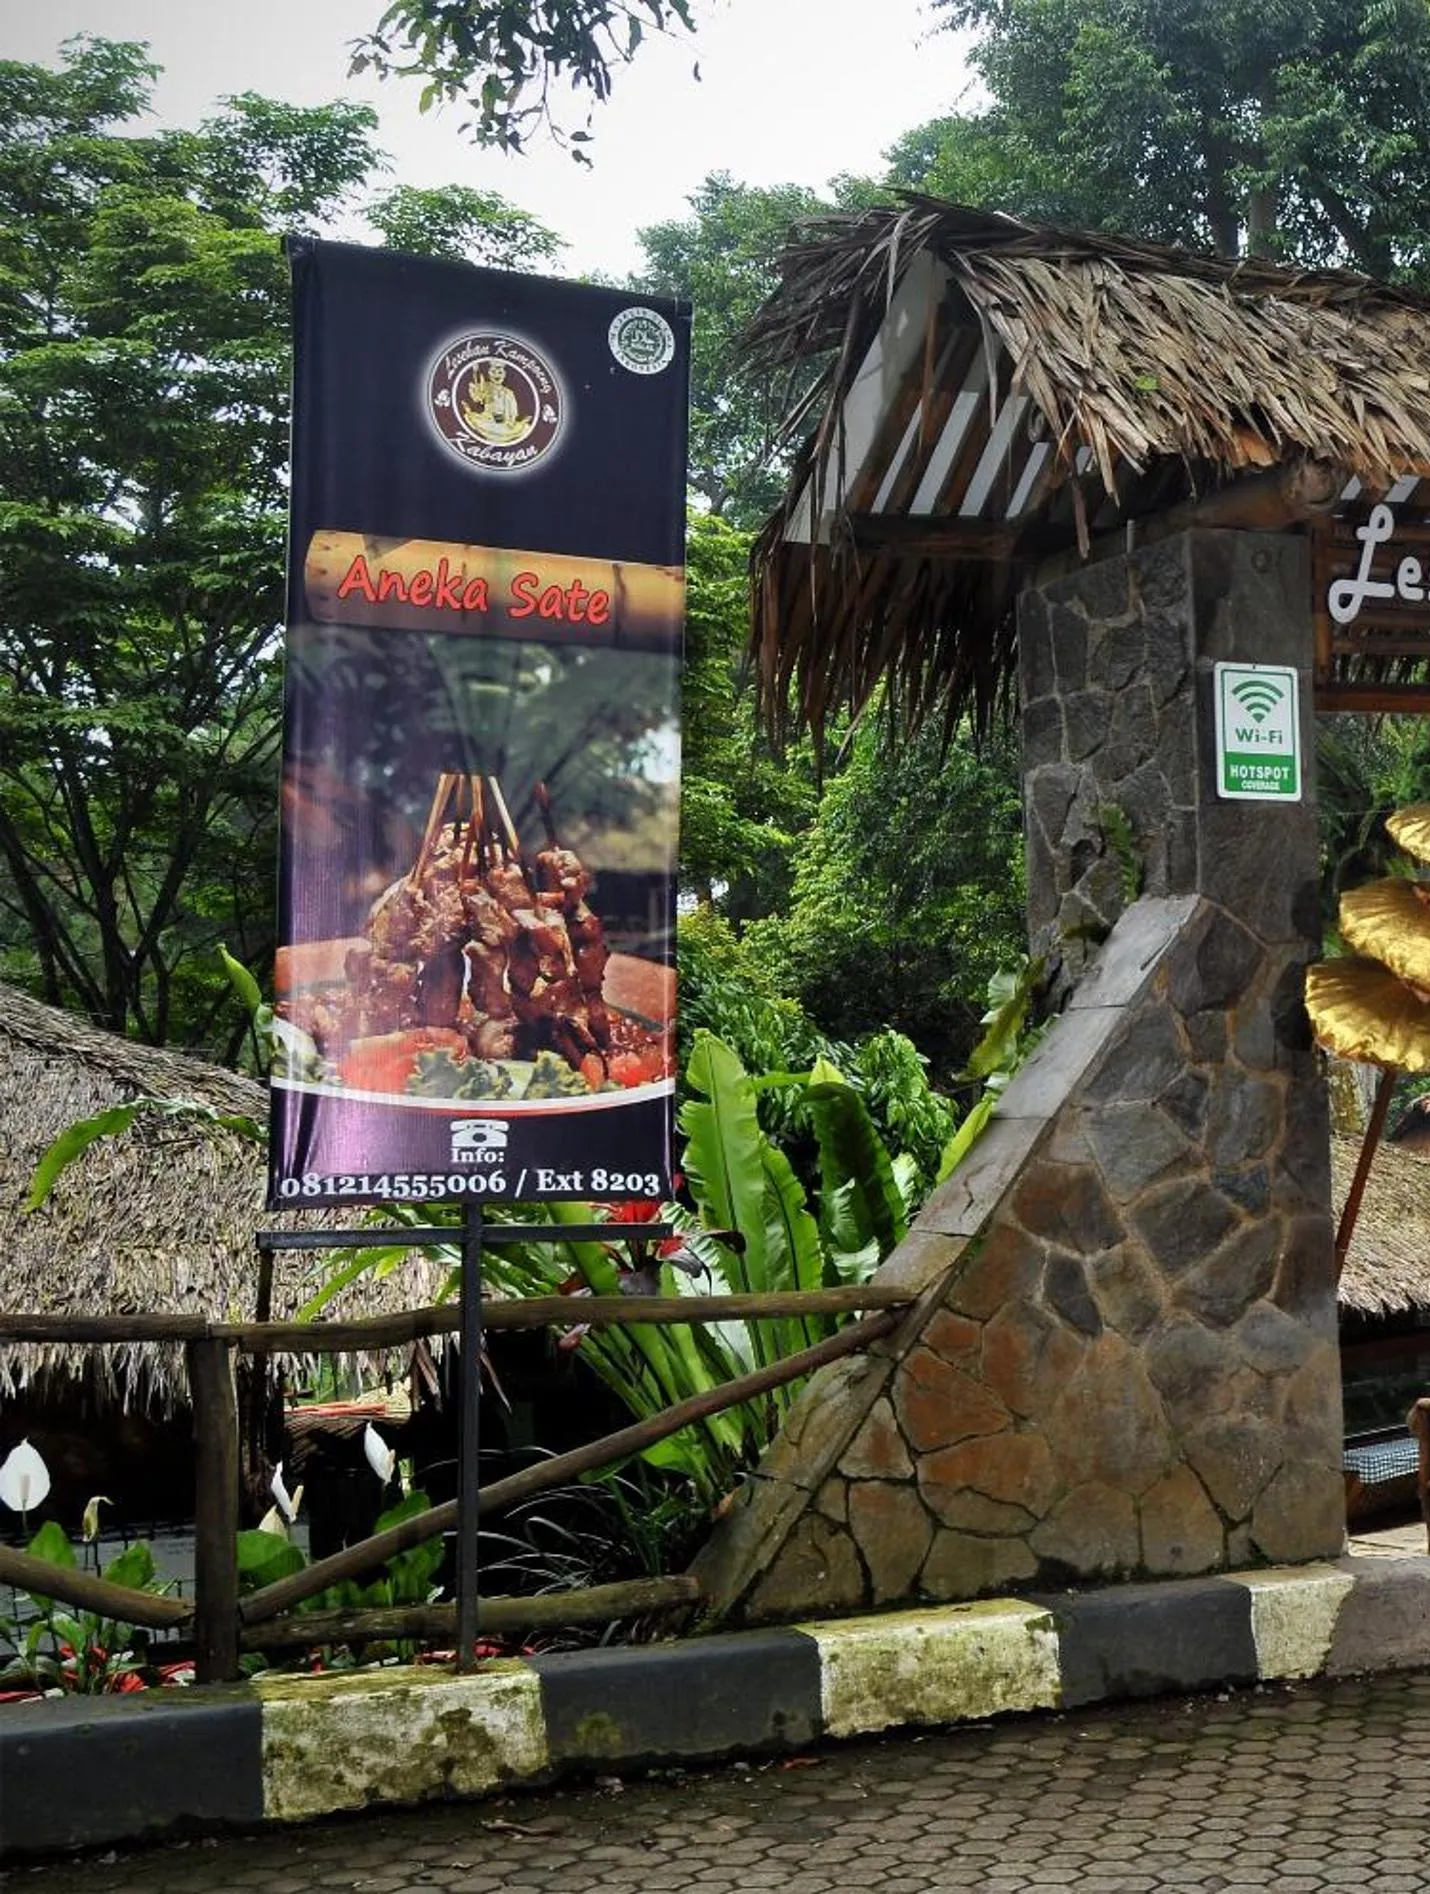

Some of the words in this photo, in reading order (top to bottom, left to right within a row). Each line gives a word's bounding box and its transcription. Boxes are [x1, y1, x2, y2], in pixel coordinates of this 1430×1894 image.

[448, 431, 538, 467] Kabayan
[337, 554, 489, 612] Aneka
[509, 572, 610, 624] Sate
[1235, 728, 1283, 744] Wi-Fi
[1230, 764, 1290, 780] HOTSPOT
[450, 1147, 505, 1164] Info:
[281, 1171, 507, 1199] 081214555006
[515, 1168, 528, 1198] /
[536, 1169, 584, 1192] Ext
[591, 1169, 660, 1195] 8203
